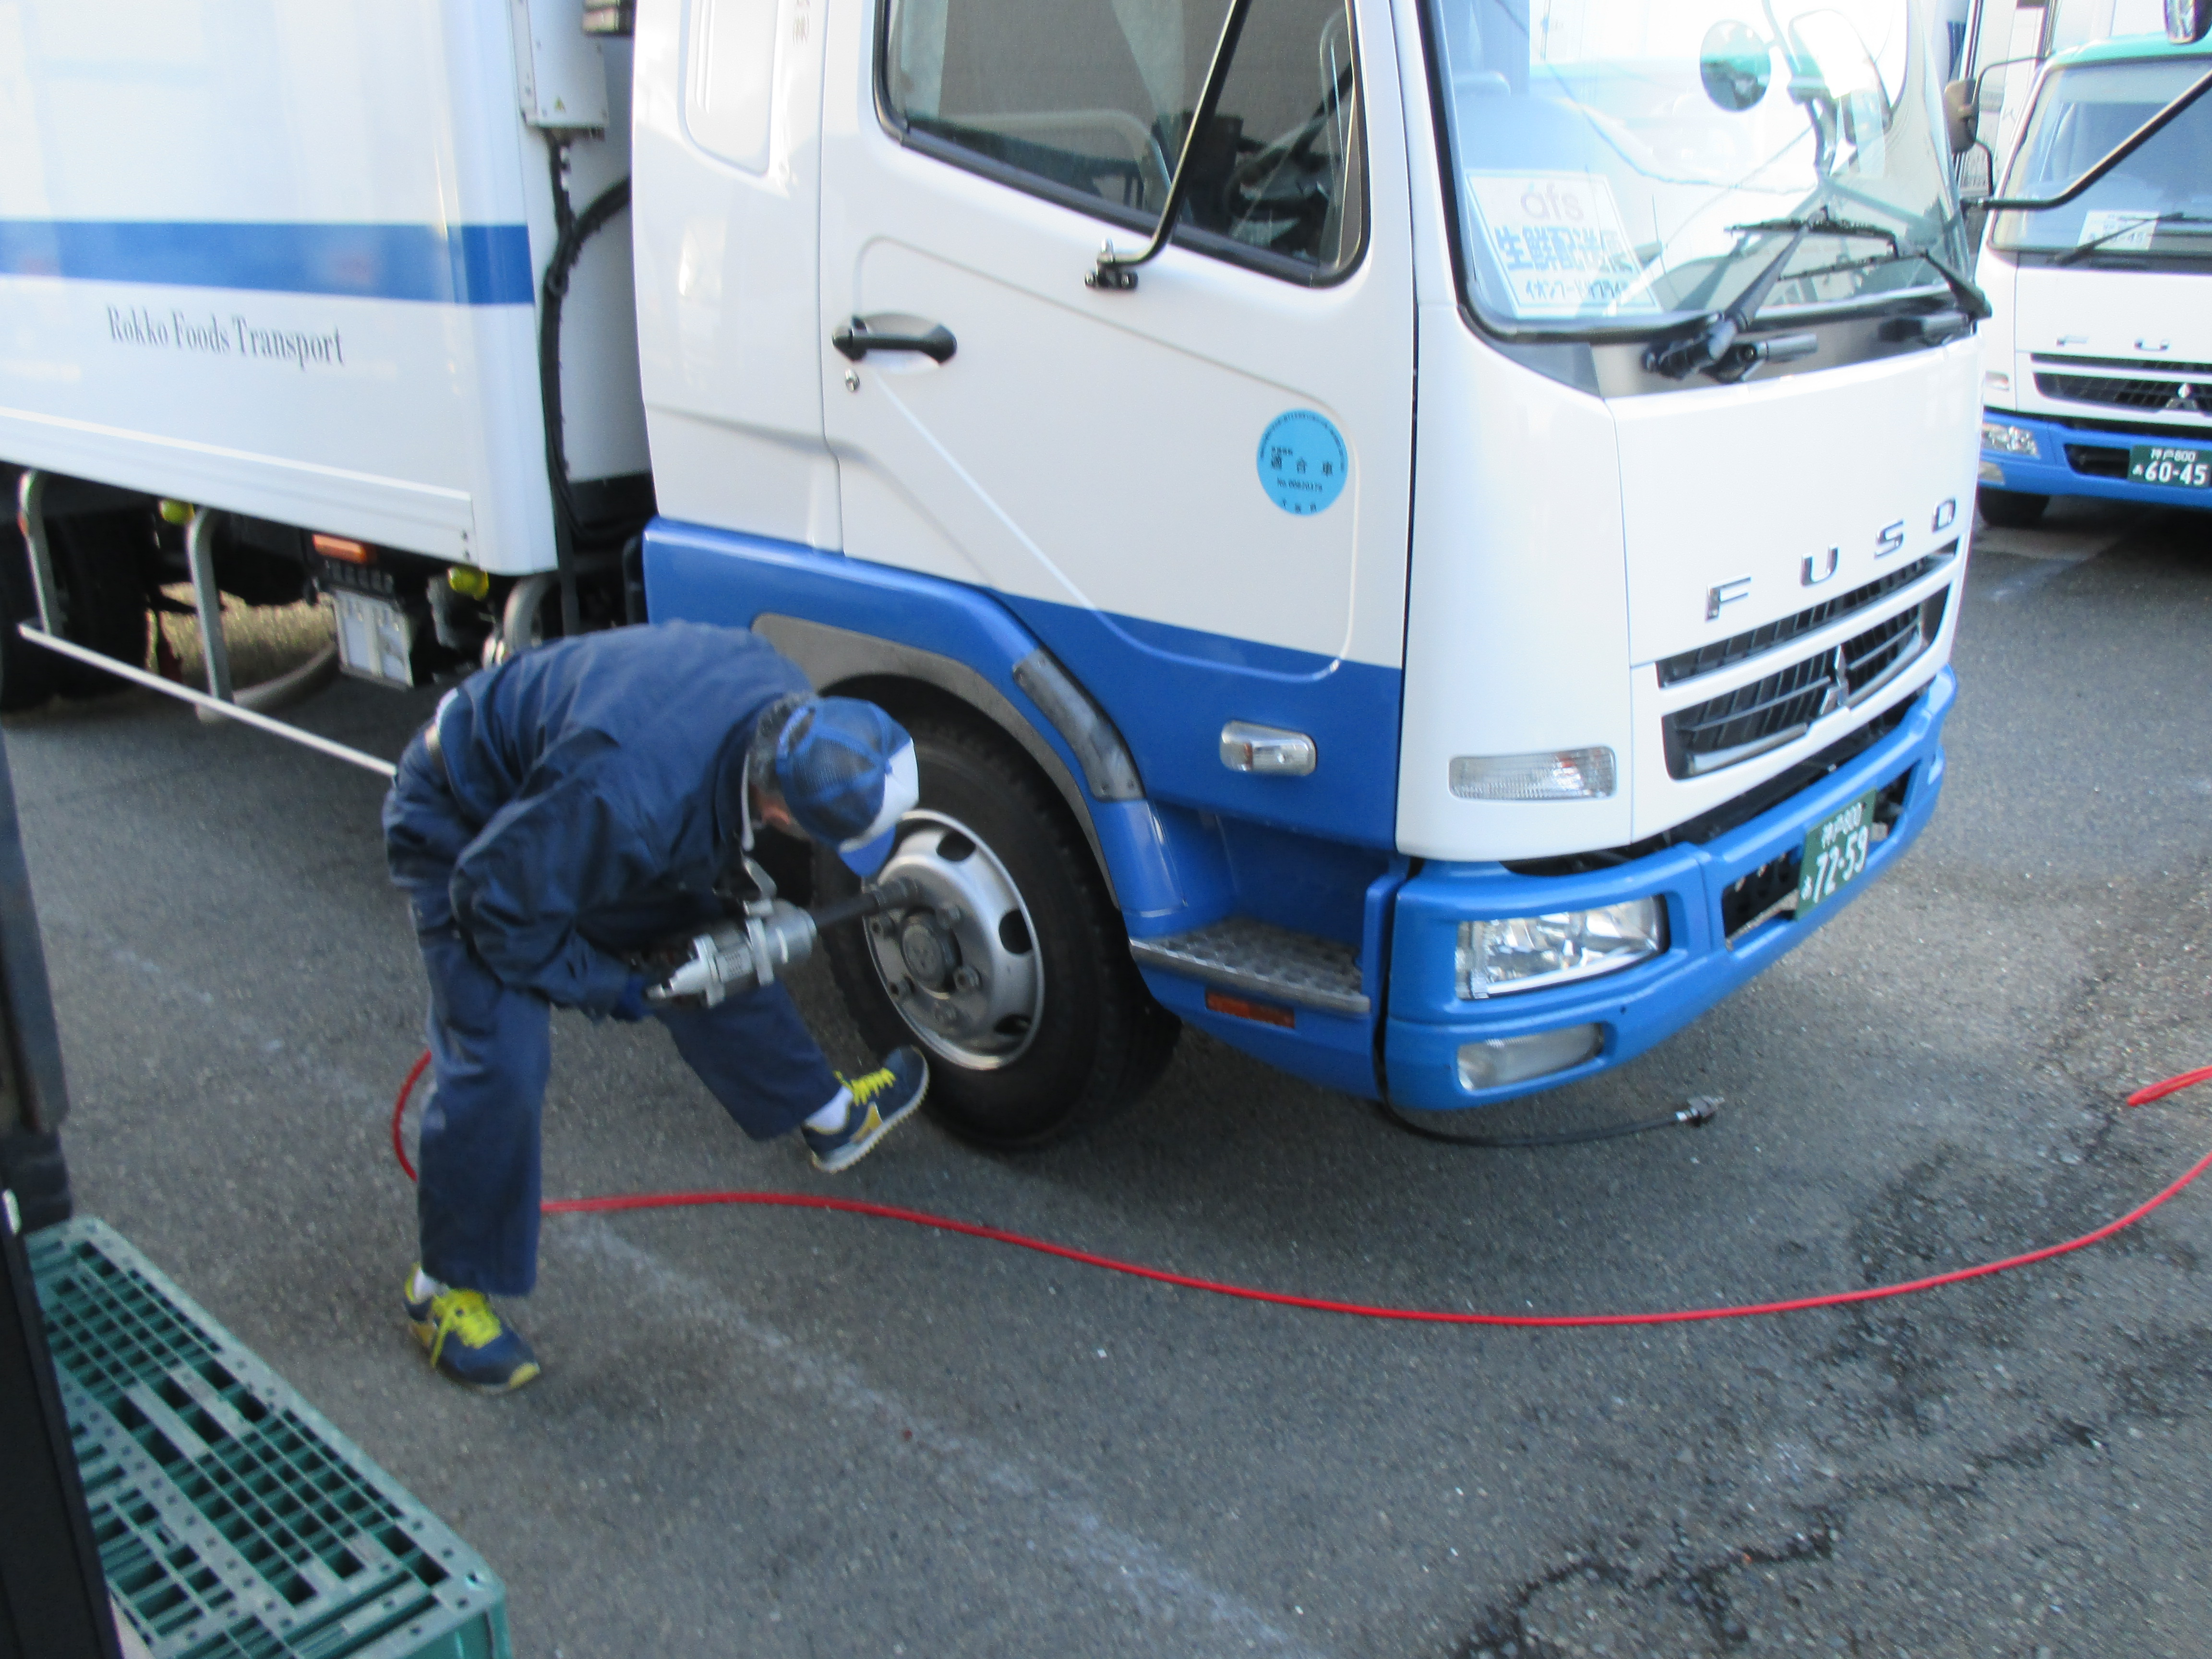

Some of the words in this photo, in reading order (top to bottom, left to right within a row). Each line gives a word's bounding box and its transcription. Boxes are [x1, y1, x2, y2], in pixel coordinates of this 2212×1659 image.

[107, 304, 168, 346] Rokko
[172, 308, 231, 355] Foods
[232, 314, 345, 372] Transport
[2144, 460, 2210, 486] 60-45
[1705, 497, 1957, 622] FUSO
[1813, 825, 1869, 903] 72-59
